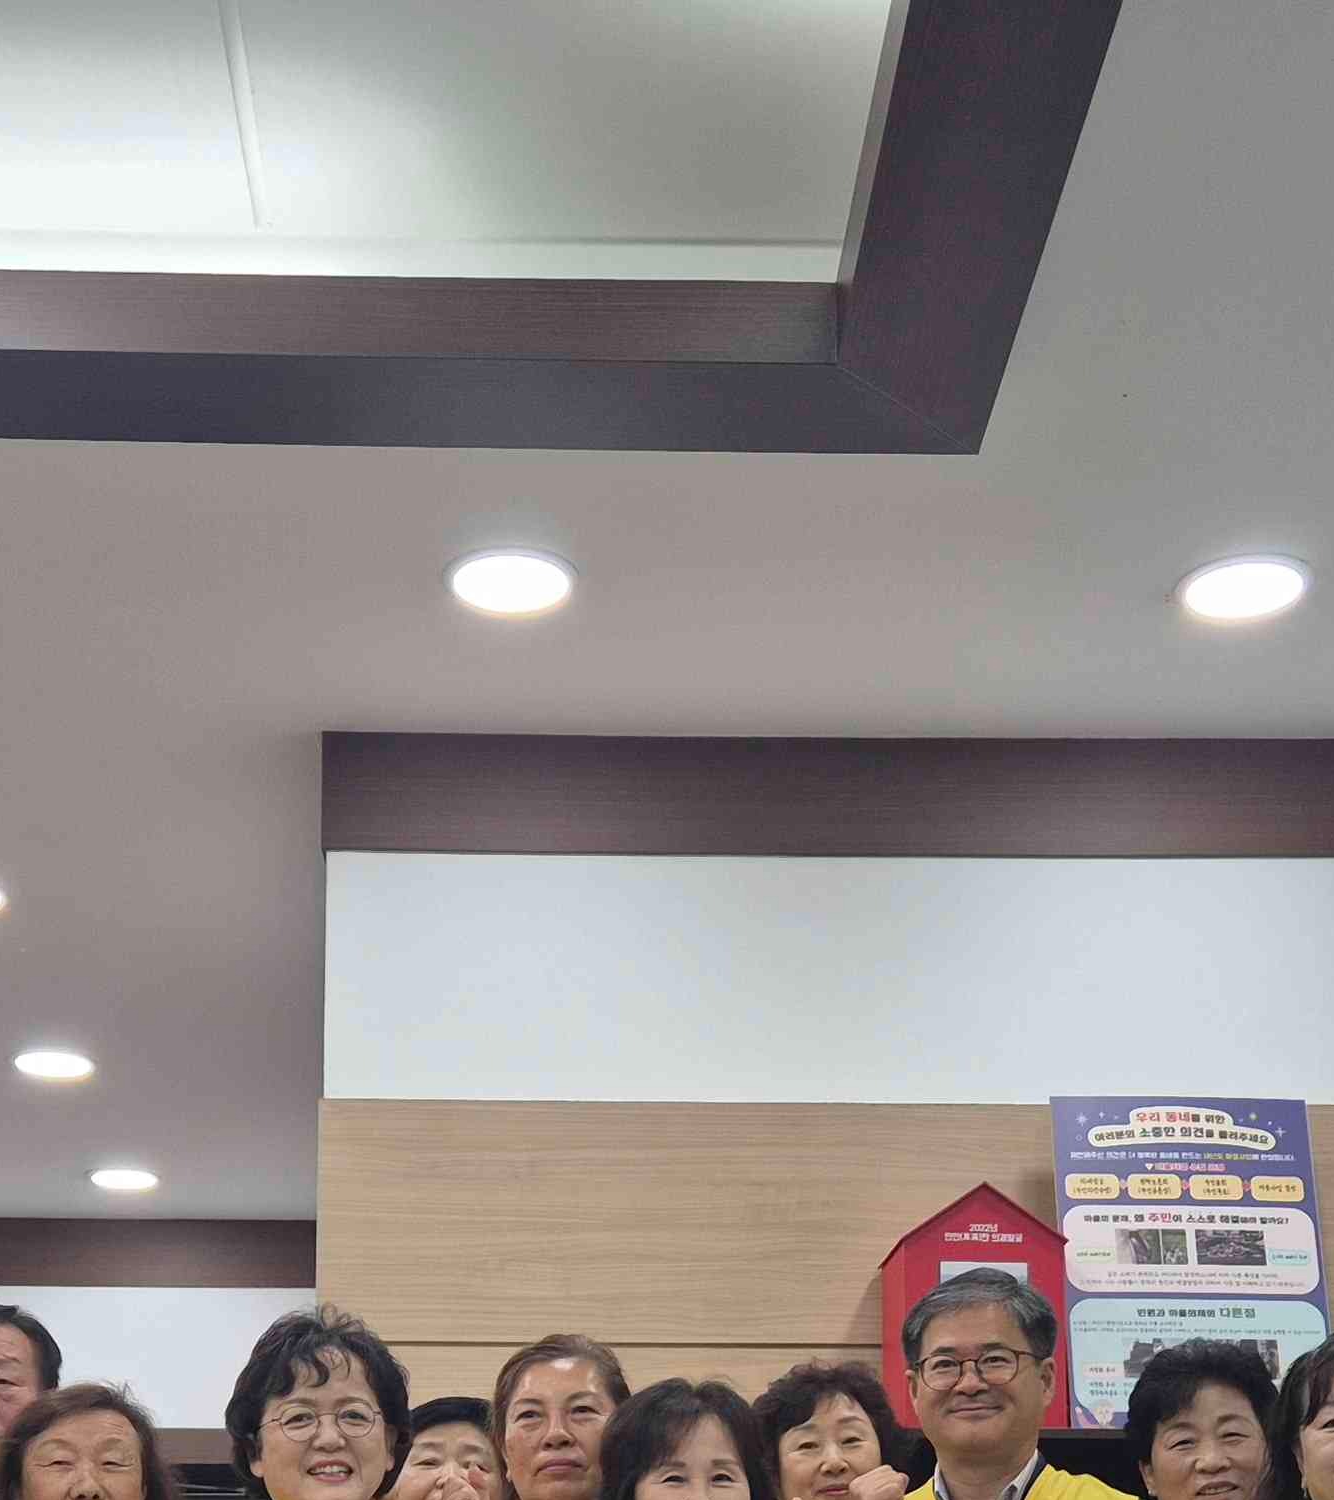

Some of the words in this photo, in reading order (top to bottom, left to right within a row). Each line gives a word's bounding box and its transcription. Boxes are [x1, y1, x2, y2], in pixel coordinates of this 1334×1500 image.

[1136, 1112, 1161, 1123] 우리
[1166, 1112, 1200, 1123] 동네를
[1094, 1130, 1135, 1142] 여러분의
[1139, 1126, 1175, 1139] 소중한
[1148, 1213, 1183, 1224] 주민이
[1185, 1214, 1217, 1224] 스스로
[1219, 1307, 1256, 1318] 다른점
